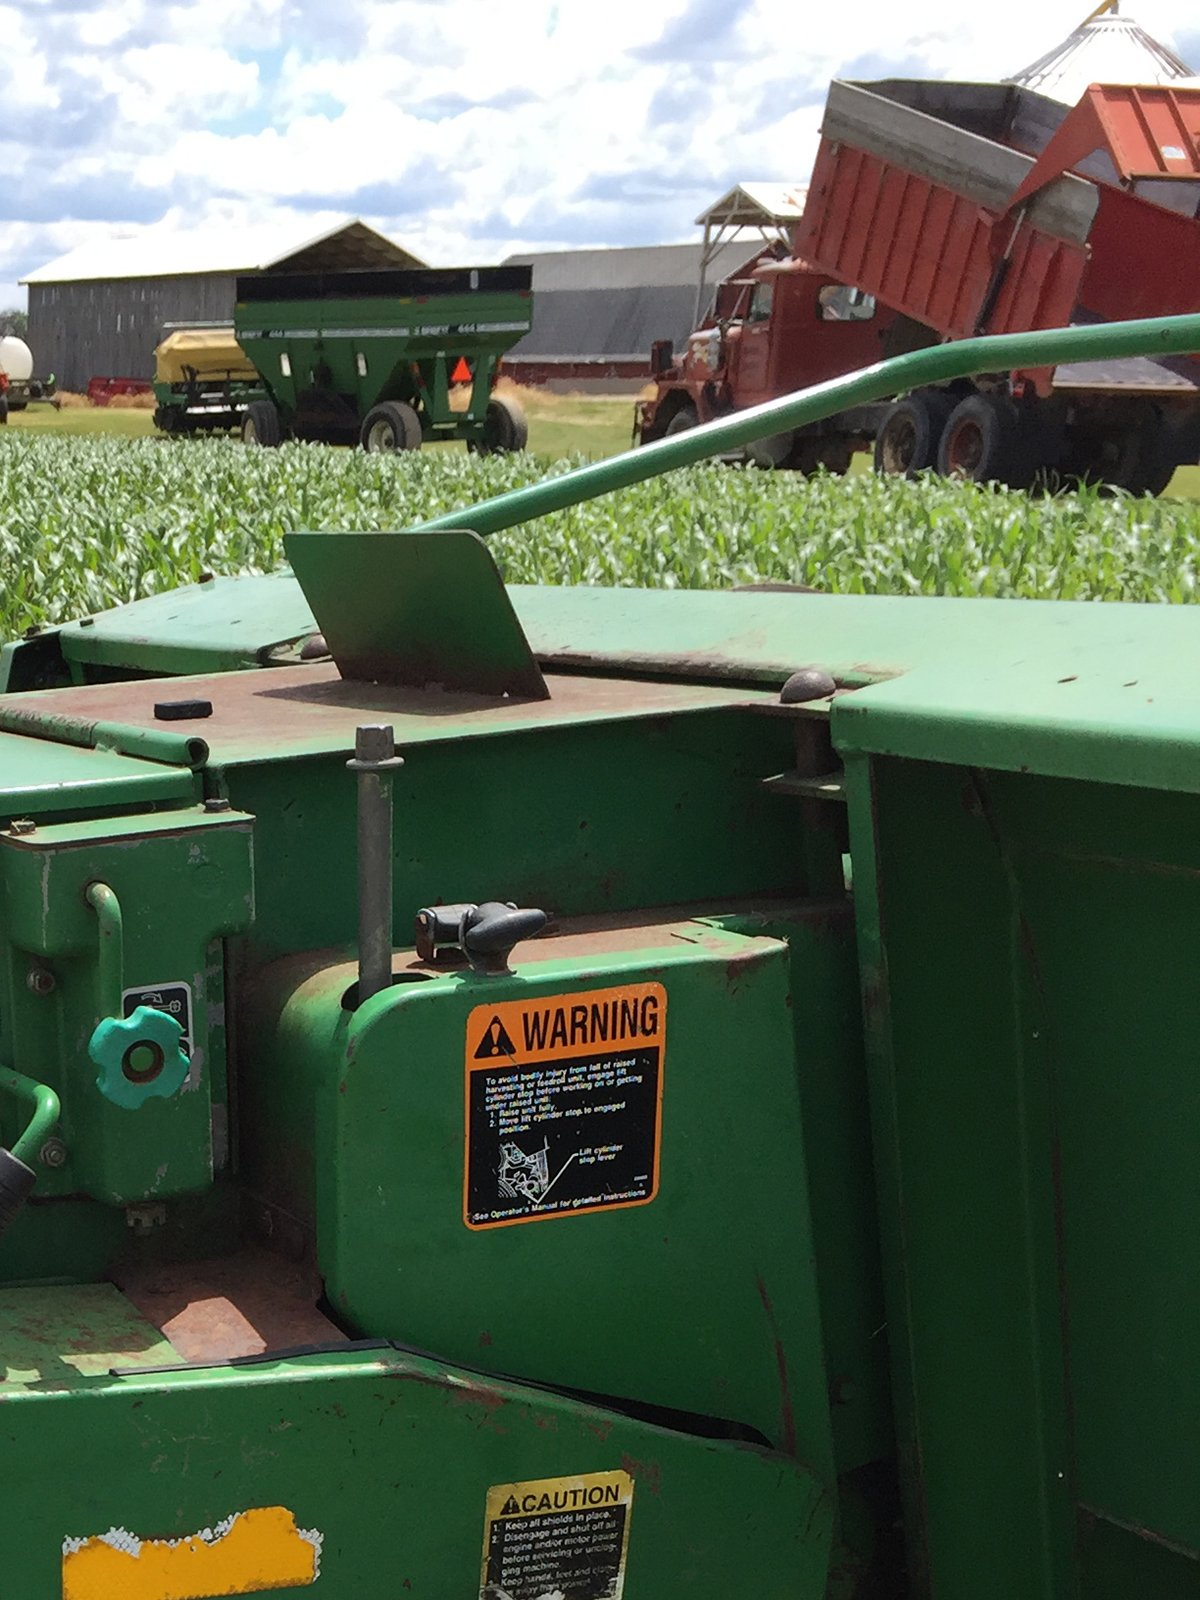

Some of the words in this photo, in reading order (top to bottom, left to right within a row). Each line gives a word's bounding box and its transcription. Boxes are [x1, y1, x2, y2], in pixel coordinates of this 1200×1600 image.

[522, 995, 659, 1051] WARNING
[486, 1077, 497, 1085] To
[498, 1074, 518, 1084] avoid
[545, 1068, 567, 1080] injury
[569, 1066, 587, 1074] from
[589, 1062, 601, 1071] fall
[603, 1061, 611, 1069] of
[613, 1058, 636, 1068] raised
[486, 1083, 525, 1094] harvesting
[526, 1081, 536, 1089] or
[587, 1070, 615, 1080] engage
[485, 1092, 515, 1103] cylinder
[517, 1090, 534, 1099] stop
[536, 1086, 560, 1096] before
[562, 1082, 593, 1092] working
[594, 1080, 605, 1088] on
[605, 1078, 615, 1086] or
[616, 1075, 643, 1087] getting
[485, 1102, 507, 1112] under
[509, 1098, 532, 1108] raised
[489, 1120, 497, 1128] 2.
[499, 1117, 519, 1127] Move
[521, 1114, 531, 1123] lift
[533, 1111, 563, 1122] cylinder
[583, 1106, 592, 1114] to
[594, 1101, 626, 1113] engaged
[499, 1108, 519, 1118] Raise
[521, 1106, 536, 1114] unit
[579, 1147, 592, 1156] Lift
[594, 1144, 623, 1155] cylinder
[579, 1156, 596, 1165] stop
[597, 1153, 616, 1162] lever
[473, 1212, 489, 1220] See
[490, 1206, 530, 1219] Operator's
[531, 1201, 558, 1212] Manual
[560, 1199, 571, 1208] for
[572, 1195, 602, 1208] detailed
[522, 1485, 620, 1512] CAUTION
[504, 1530, 550, 1542] Disengage
[551, 1526, 569, 1536] and
[570, 1523, 591, 1533] shut
[592, 1521, 604, 1531] off
[605, 1520, 616, 1529] all
[505, 1520, 528, 1531] Keep
[529, 1518, 541, 1528] all
[542, 1514, 573, 1526] shields
[575, 1513, 584, 1521] in
[585, 1511, 611, 1522] place.
[503, 1543, 533, 1554] engine
[534, 1539, 562, 1549] and/or
[564, 1535, 590, 1545] motor
[592, 1532, 618, 1543] power
[502, 1553, 530, 1564] before
[532, 1548, 572, 1560] servicing
[574, 1547, 583, 1555] or
[501, 1567, 520, 1577] ging
[501, 1577, 523, 1587] Keep
[574, 1567, 591, 1577] and
